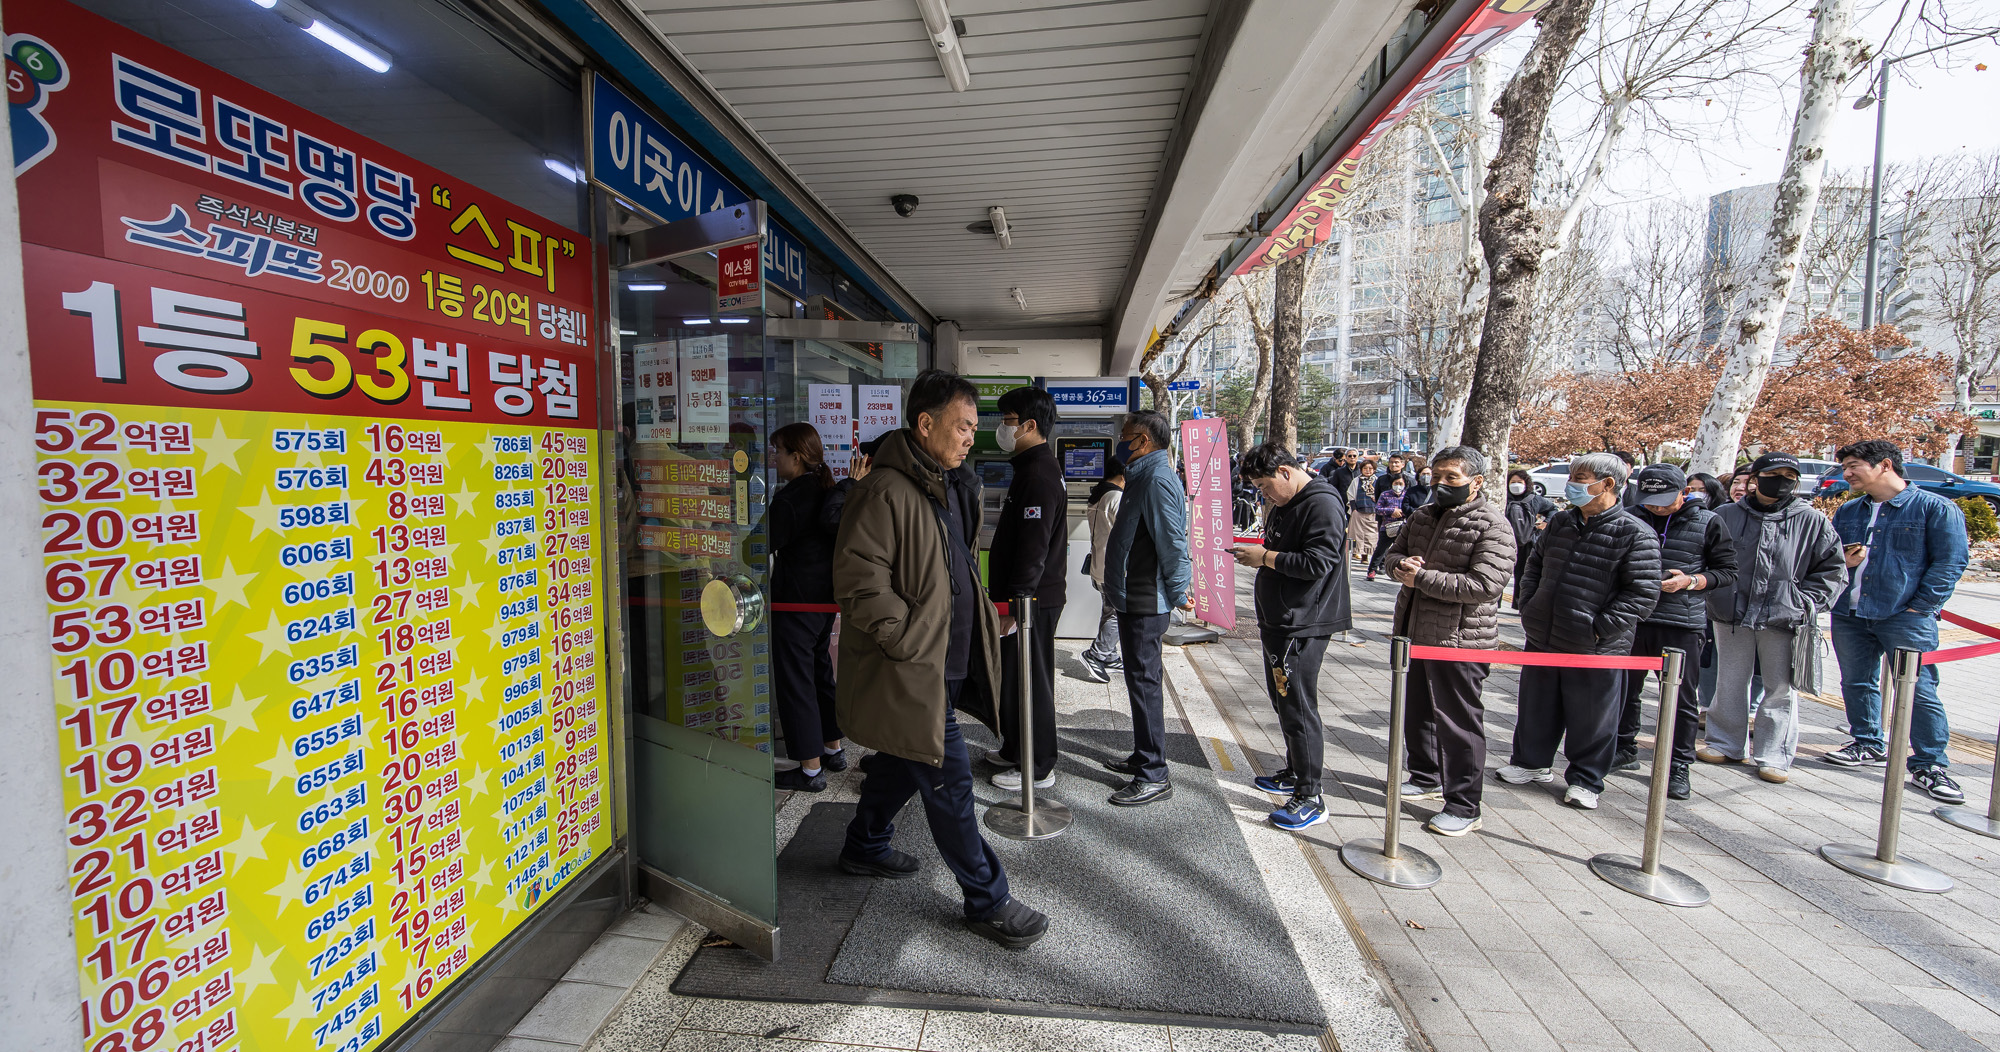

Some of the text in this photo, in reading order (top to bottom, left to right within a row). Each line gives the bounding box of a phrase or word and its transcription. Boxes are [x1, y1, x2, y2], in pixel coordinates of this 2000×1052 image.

[7, 70, 24, 93] 5
[27, 51, 43, 71] 6
[112, 52, 419, 241] 로또명당
[609, 111, 702, 216] 이곳이
[196, 195, 319, 246] 즉석식복권
[120, 204, 410, 303] 스피또 2000
[724, 258, 752, 278] 에스원
[420, 269, 588, 347] 1등 20억 당첨!!
[719, 297, 742, 308] SECOM
[62, 281, 578, 418] 1등 53번 당첨
[691, 368, 716, 382] 53번째
[638, 371, 673, 388] 1등 당첨
[686, 392, 700, 408] 1등
[703, 391, 722, 407] 당첨
[36, 412, 191, 452] 52억원
[815, 415, 847, 425] 1등 당첨
[819, 402, 842, 410] 53번째
[863, 415, 897, 425] 2등 당첨
[867, 402, 893, 411] 233번째
[275, 425, 442, 453] 575회 16억원
[493, 432, 586, 454] 786회 45억원
[650, 428, 672, 439] 20억원
[39, 462, 194, 502] 32억원
[276, 459, 443, 490] 576회 43억원
[494, 458, 587, 480] 826회 20억원
[280, 492, 445, 528] 598회 8억원
[496, 483, 588, 509] 835회 12억원
[497, 508, 589, 536] 837회 31억원
[42, 511, 197, 553] 20억원
[282, 525, 446, 566] 606회 13억원
[498, 533, 590, 566] 871회 27억원
[46, 557, 201, 603] 67억원
[284, 557, 448, 605] 606회 13억원
[499, 559, 591, 592] 876회 10억원
[501, 582, 591, 620] 943회 34억원
[52, 600, 204, 653] 53억원
[287, 588, 449, 642] 624회 27억원
[502, 605, 593, 648] 979회 16억원
[61, 643, 207, 699] 10억원
[289, 620, 451, 682] 635회 18억원
[503, 629, 593, 675] 979회 16억원
[292, 650, 453, 719] 647회 21억원
[504, 653, 594, 702] 996회 14억원
[65, 686, 210, 748] 17억원
[294, 681, 454, 757] 655회 16억원
[498, 680, 595, 732] 1005회 20억원
[500, 701, 596, 762] 1013회 50억원
[70, 728, 213, 795] 19억원
[297, 711, 455, 795] 655회 16억원
[501, 722, 597, 788] 1041회 9억원
[300, 741, 457, 832] 663회 20억원
[502, 745, 598, 816] 1075회 28억원
[504, 768, 598, 843] 1111회 17억원
[69, 769, 216, 846] 32억원
[302, 771, 458, 868] 668회 30억원
[505, 790, 599, 870] 1121회 25억원
[73, 810, 220, 897] 21억원
[305, 800, 460, 905] 674회 17억원
[506, 812, 600, 896] 1146회 25억원
[83, 851, 222, 934] 10억원
[307, 829, 462, 941] 685회 15억원
[87, 891, 225, 980] 17억원
[310, 859, 463, 977] 723회 21억원
[312, 890, 465, 1013] 734회 19억원
[399, 944, 468, 1011] 16억원
[314, 915, 467, 1048] 745회 7억원
